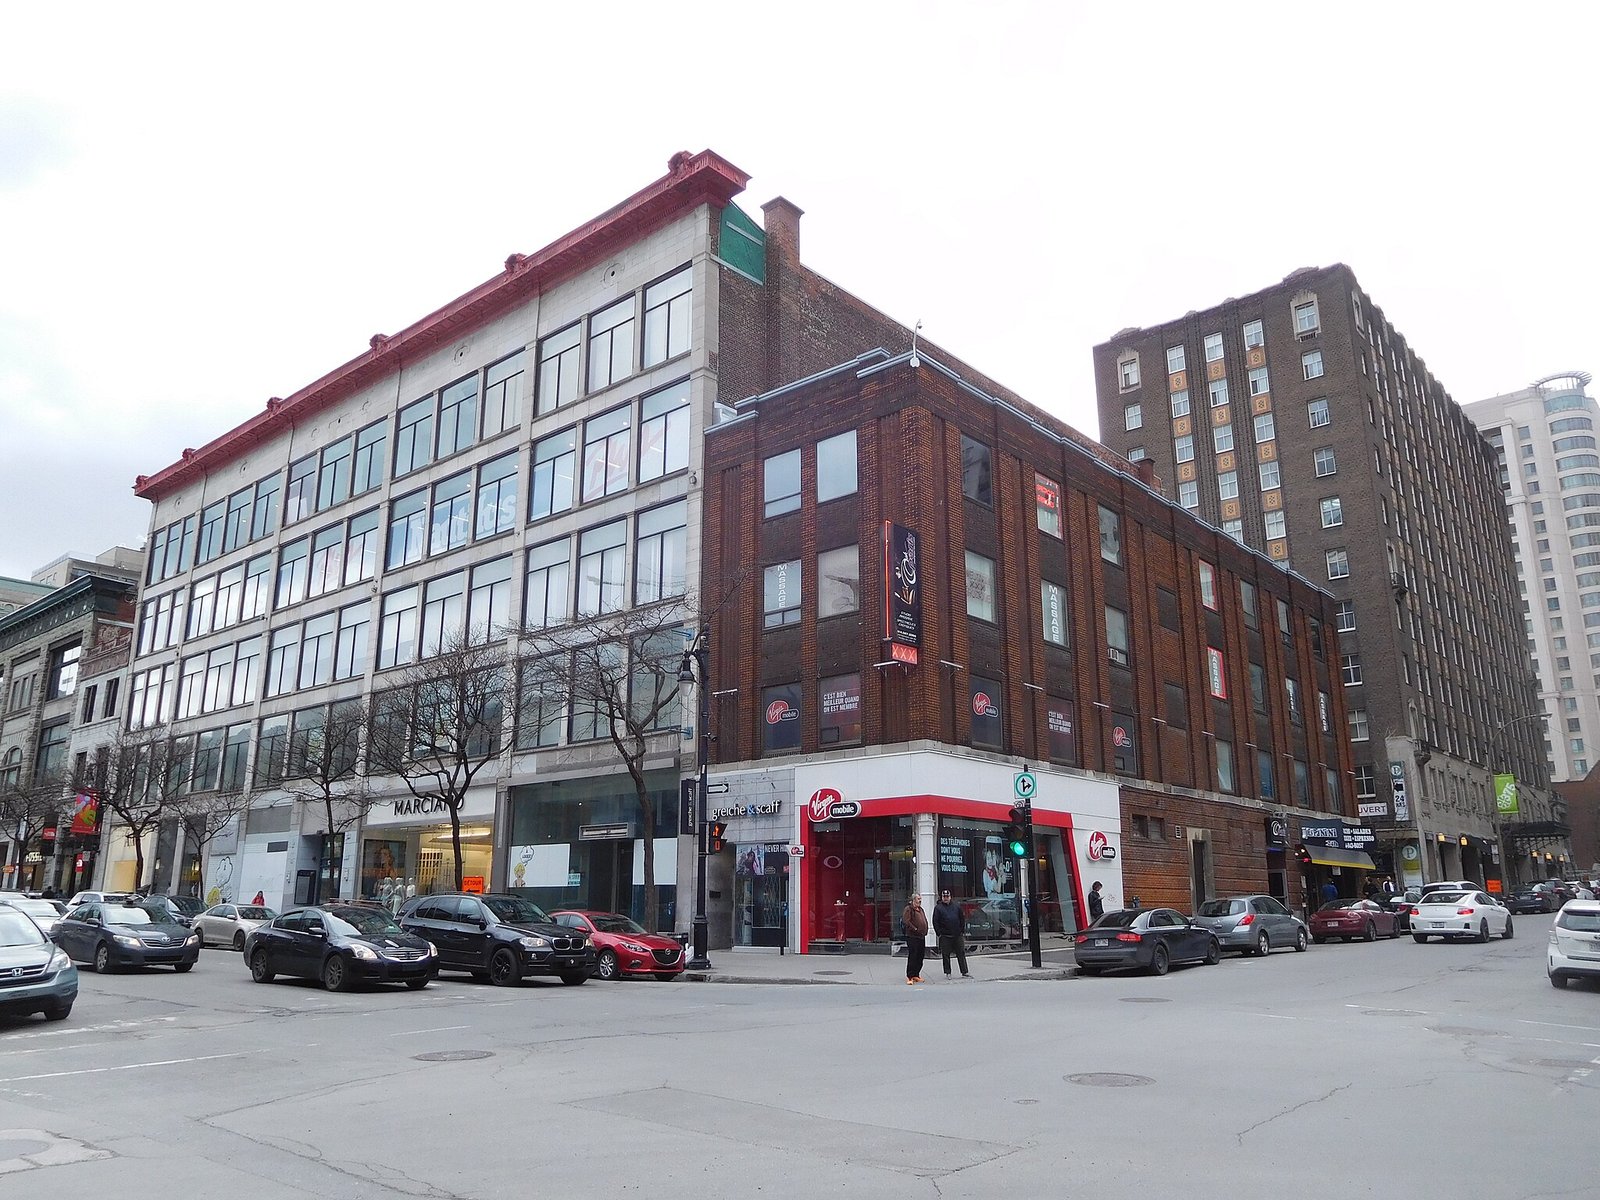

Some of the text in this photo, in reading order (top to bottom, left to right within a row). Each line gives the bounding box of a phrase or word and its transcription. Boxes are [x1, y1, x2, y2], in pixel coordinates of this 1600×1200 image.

[777, 564, 787, 608] MASSAGE
[1048, 584, 1060, 642] MASSAGE
[892, 644, 915, 662] XXX
[823, 696, 860, 707] MEILLEUR QUAND
[839, 702, 858, 711] MEMBRE
[811, 790, 855, 817] Virgin mobile
[1395, 794, 1405, 803] 24
[712, 800, 781, 821] greiche & scaff
[940, 837, 948, 845] DES
[764, 844, 780, 853] NEVER
[940, 846, 961, 855] DONT VOUS
[941, 864, 951, 872] VOUS
